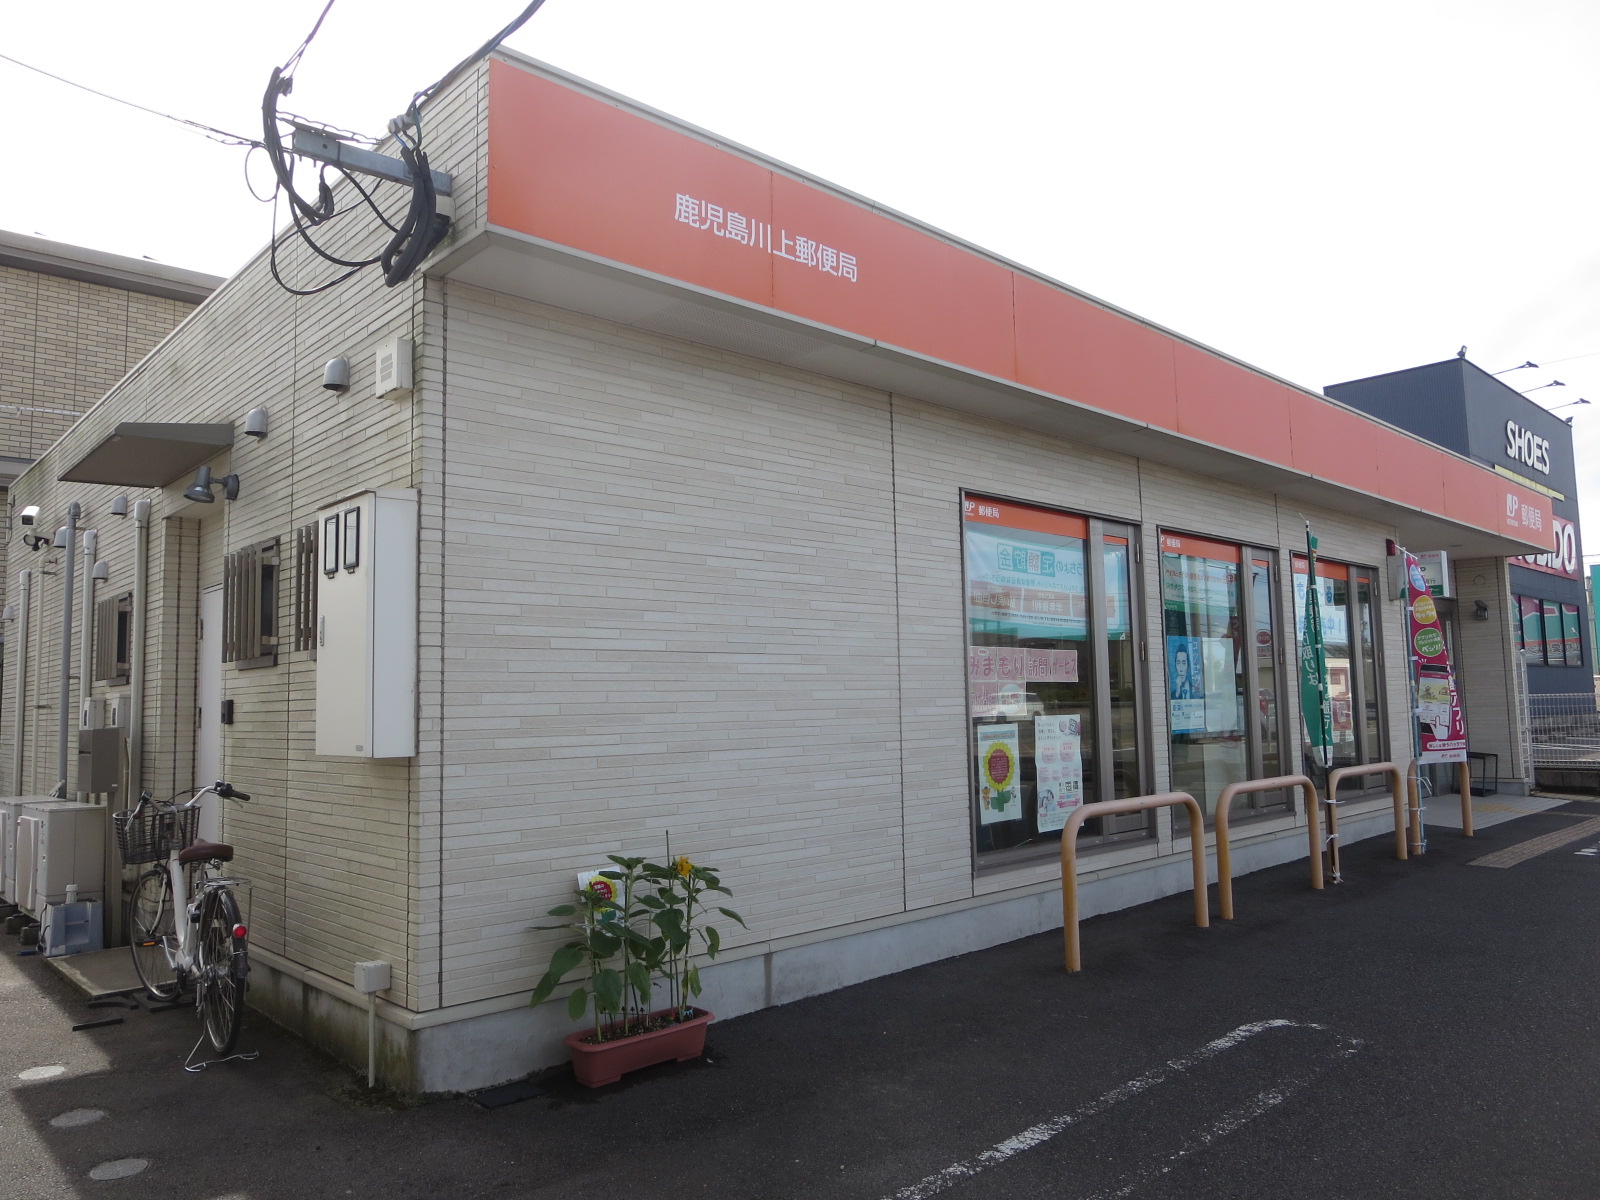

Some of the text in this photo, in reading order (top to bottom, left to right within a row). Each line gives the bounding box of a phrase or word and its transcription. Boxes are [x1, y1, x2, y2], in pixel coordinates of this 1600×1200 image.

[674, 193, 858, 283] 鹿児島川上郵便局
[1507, 420, 1550, 475] SHOES
[978, 505, 1000, 519] 郵便局
[1521, 504, 1542, 532] 郵便局
